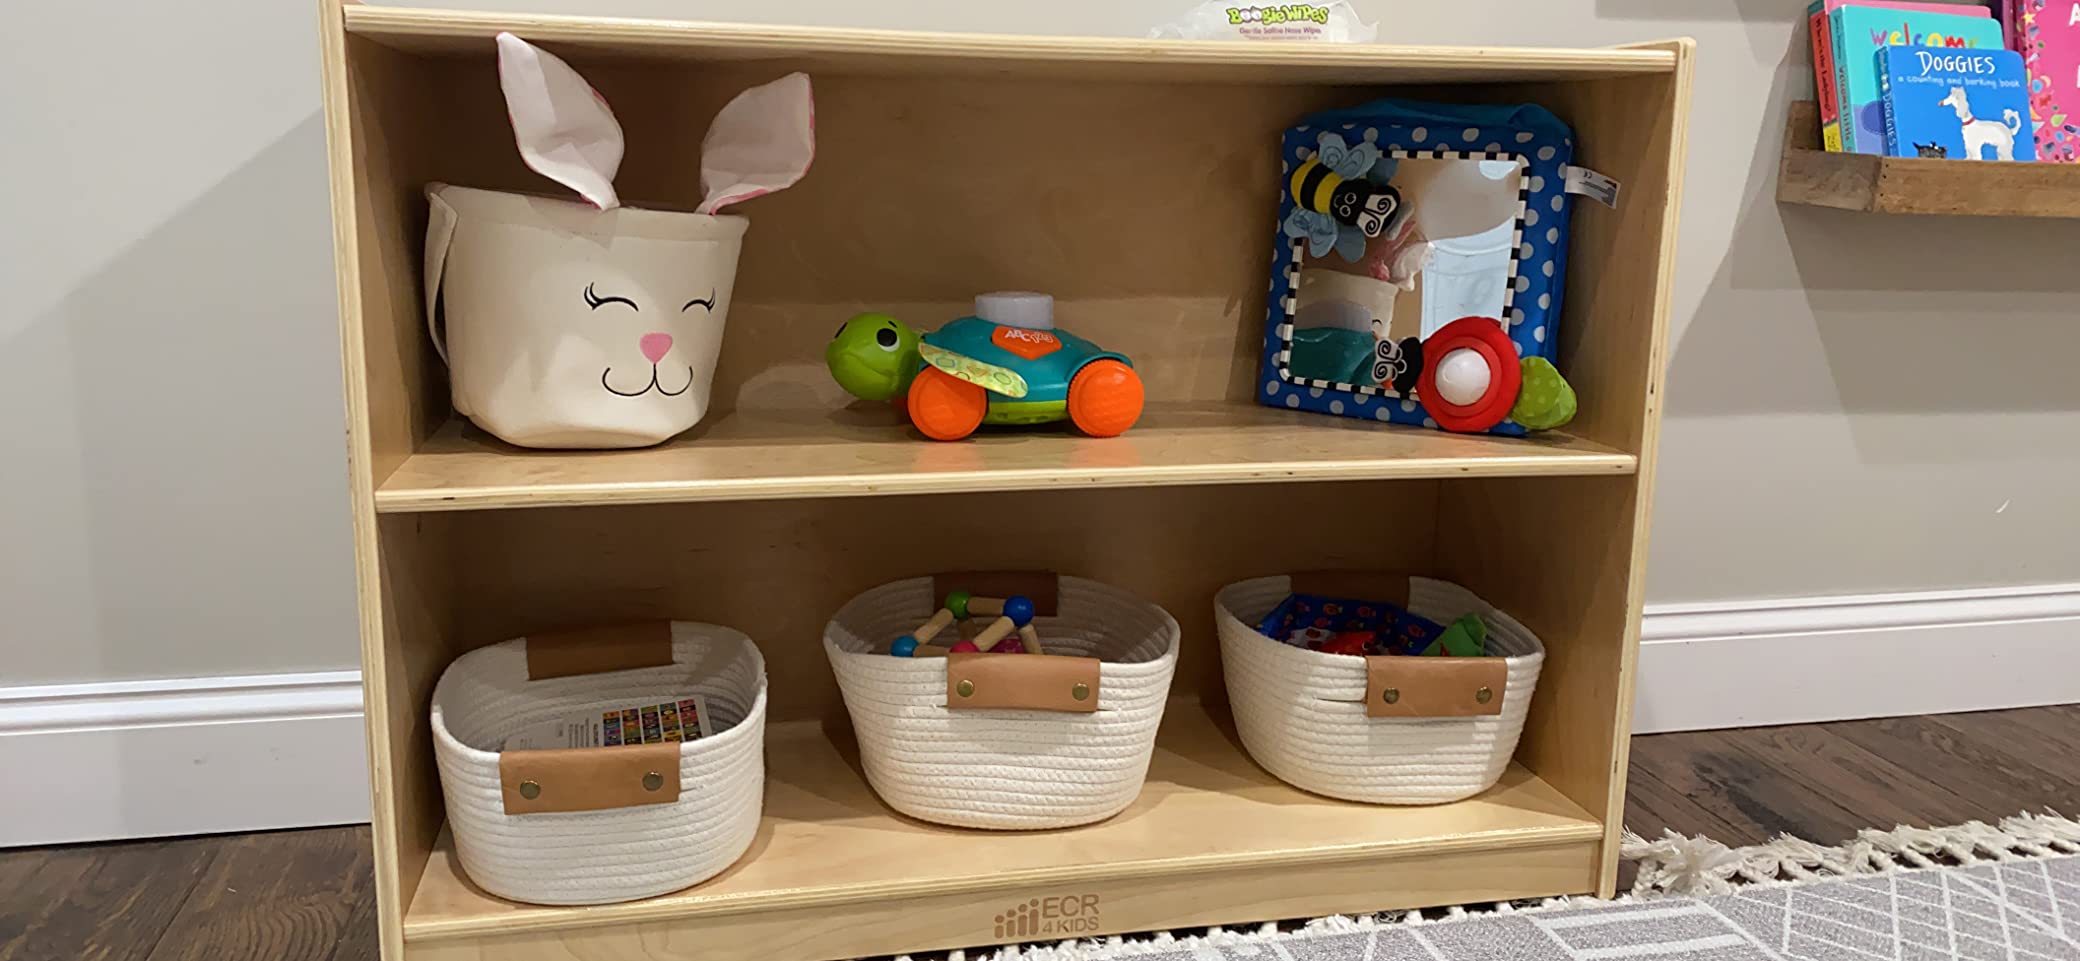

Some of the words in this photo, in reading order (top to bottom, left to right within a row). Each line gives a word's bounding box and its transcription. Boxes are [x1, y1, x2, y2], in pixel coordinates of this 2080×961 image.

[1915, 51, 1996, 76] DOGGIES
[1907, 75, 1944, 87] counting
[1946, 76, 1962, 85] and
[1965, 77, 1996, 90] barking
[2000, 79, 2020, 88] book
[1004, 329, 1031, 342] ABC
[1042, 894, 1099, 919] ECR
[1042, 921, 1052, 933] 4
[1057, 916, 1099, 933] KIDS
